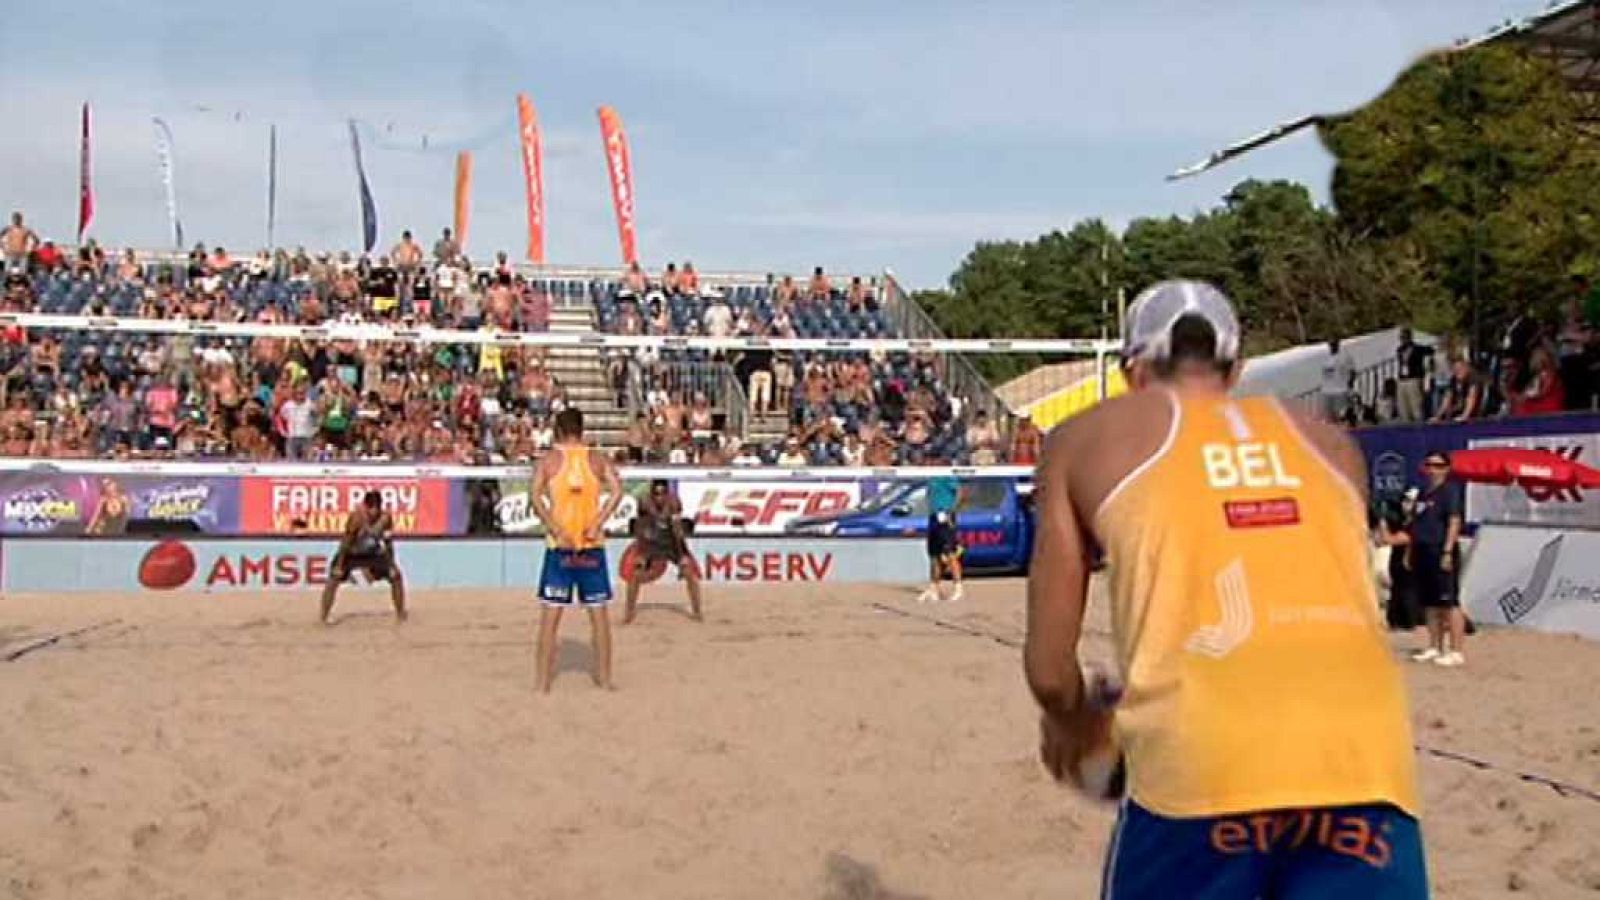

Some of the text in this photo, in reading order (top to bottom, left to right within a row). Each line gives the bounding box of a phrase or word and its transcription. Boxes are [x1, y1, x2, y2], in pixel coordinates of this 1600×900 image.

[1203, 443, 1302, 489] BEL
[273, 486, 417, 512] FAIR PAY
[205, 554, 329, 586] AMSE
